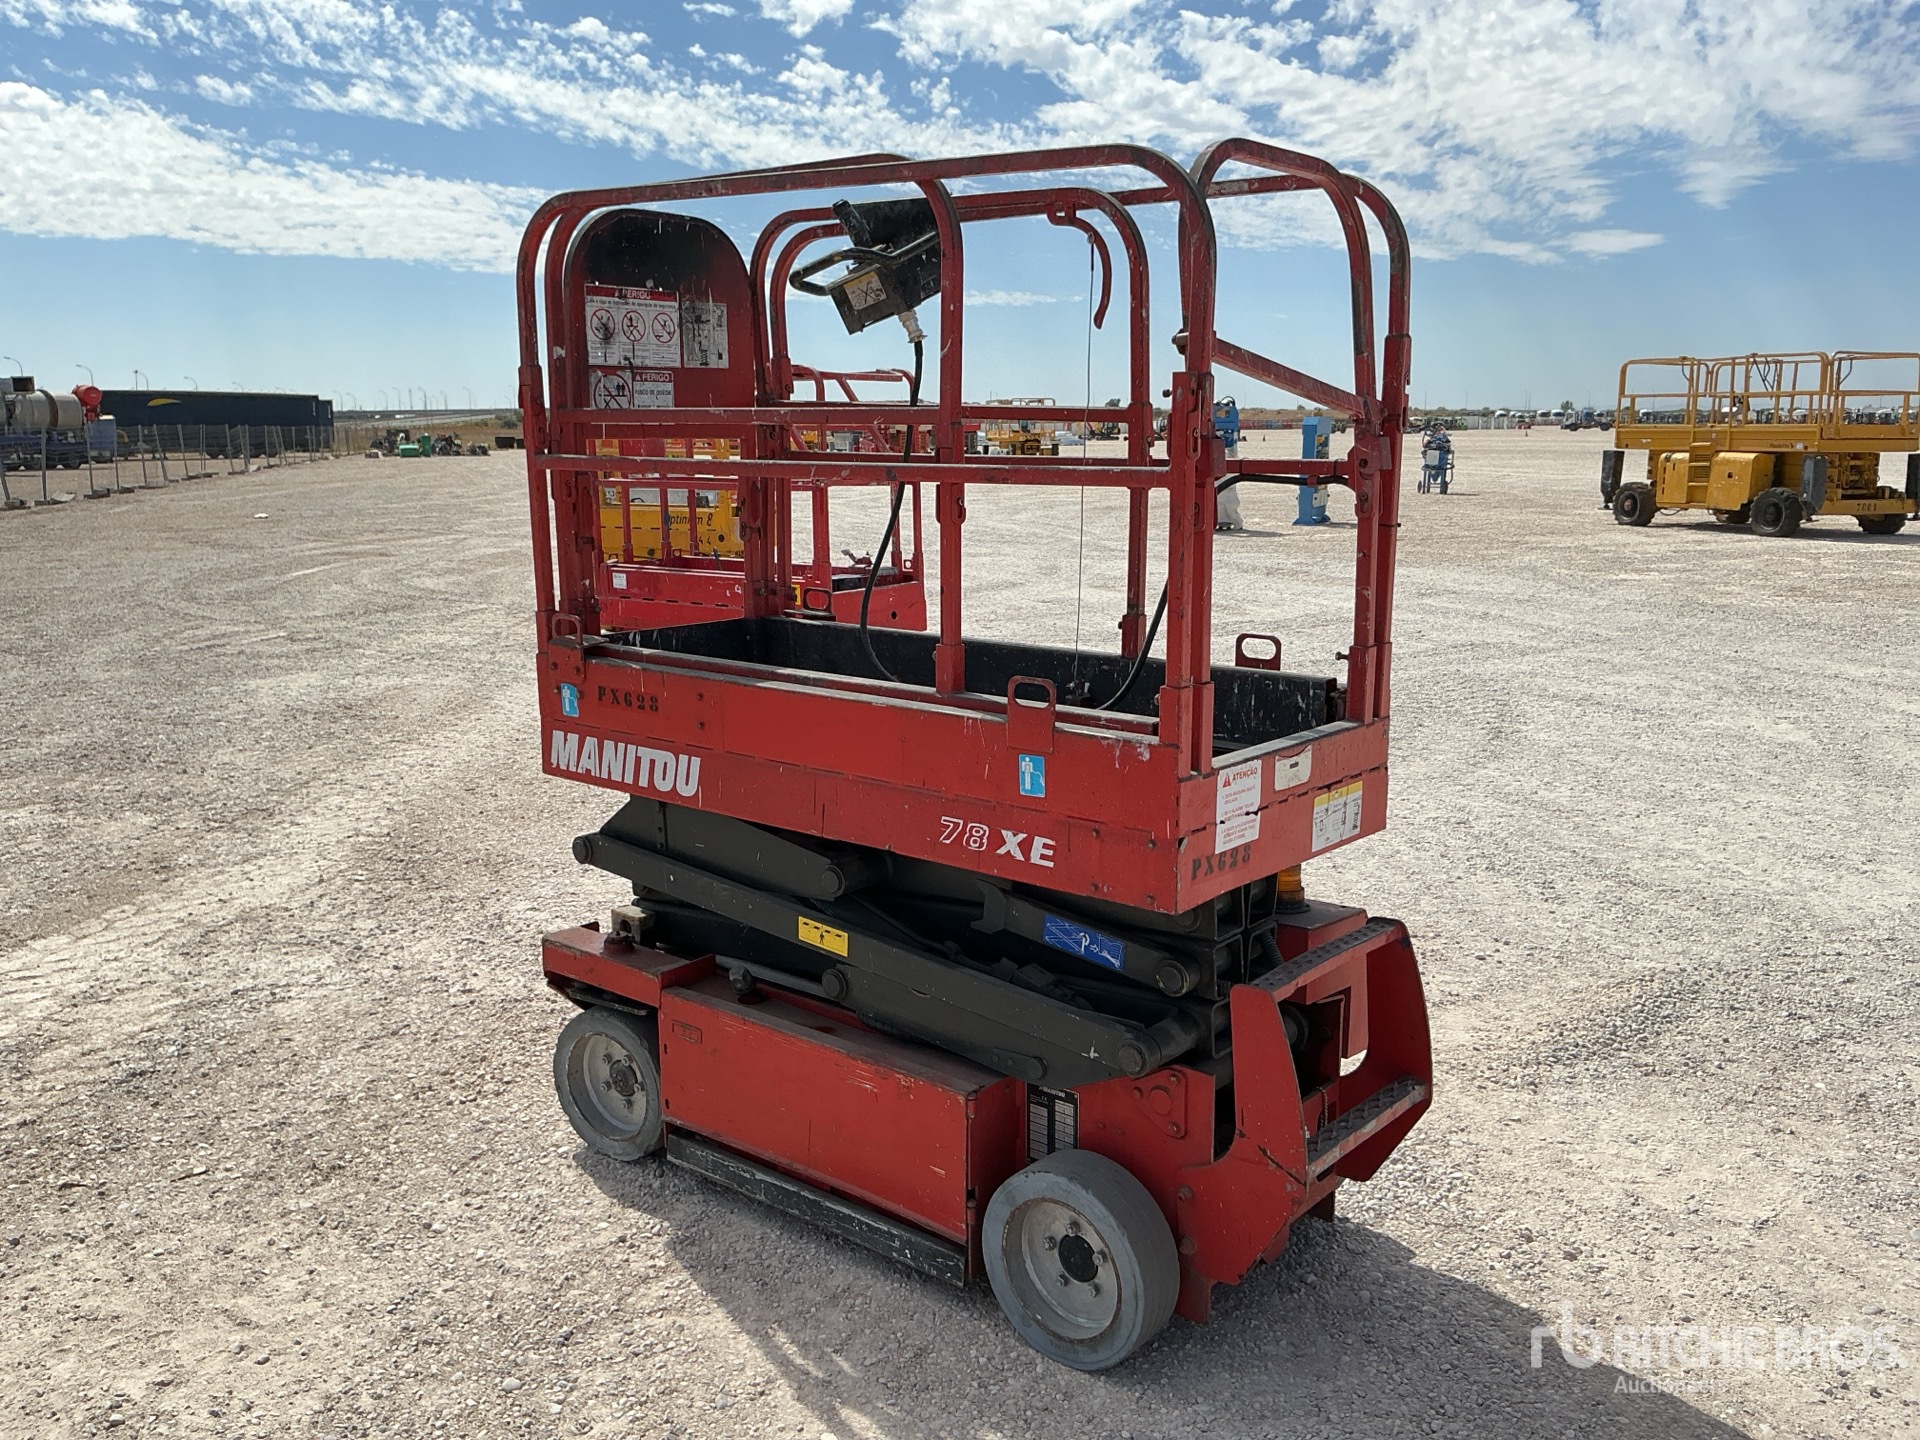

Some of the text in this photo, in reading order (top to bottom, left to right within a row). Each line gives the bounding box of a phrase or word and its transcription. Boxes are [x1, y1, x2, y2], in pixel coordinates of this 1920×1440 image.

[706, 512, 714, 526] 8
[597, 685, 660, 712] PX628
[551, 730, 701, 797] MANITOU
[939, 816, 1057, 868] 78 XE
[1191, 845, 1252, 880] PX628
